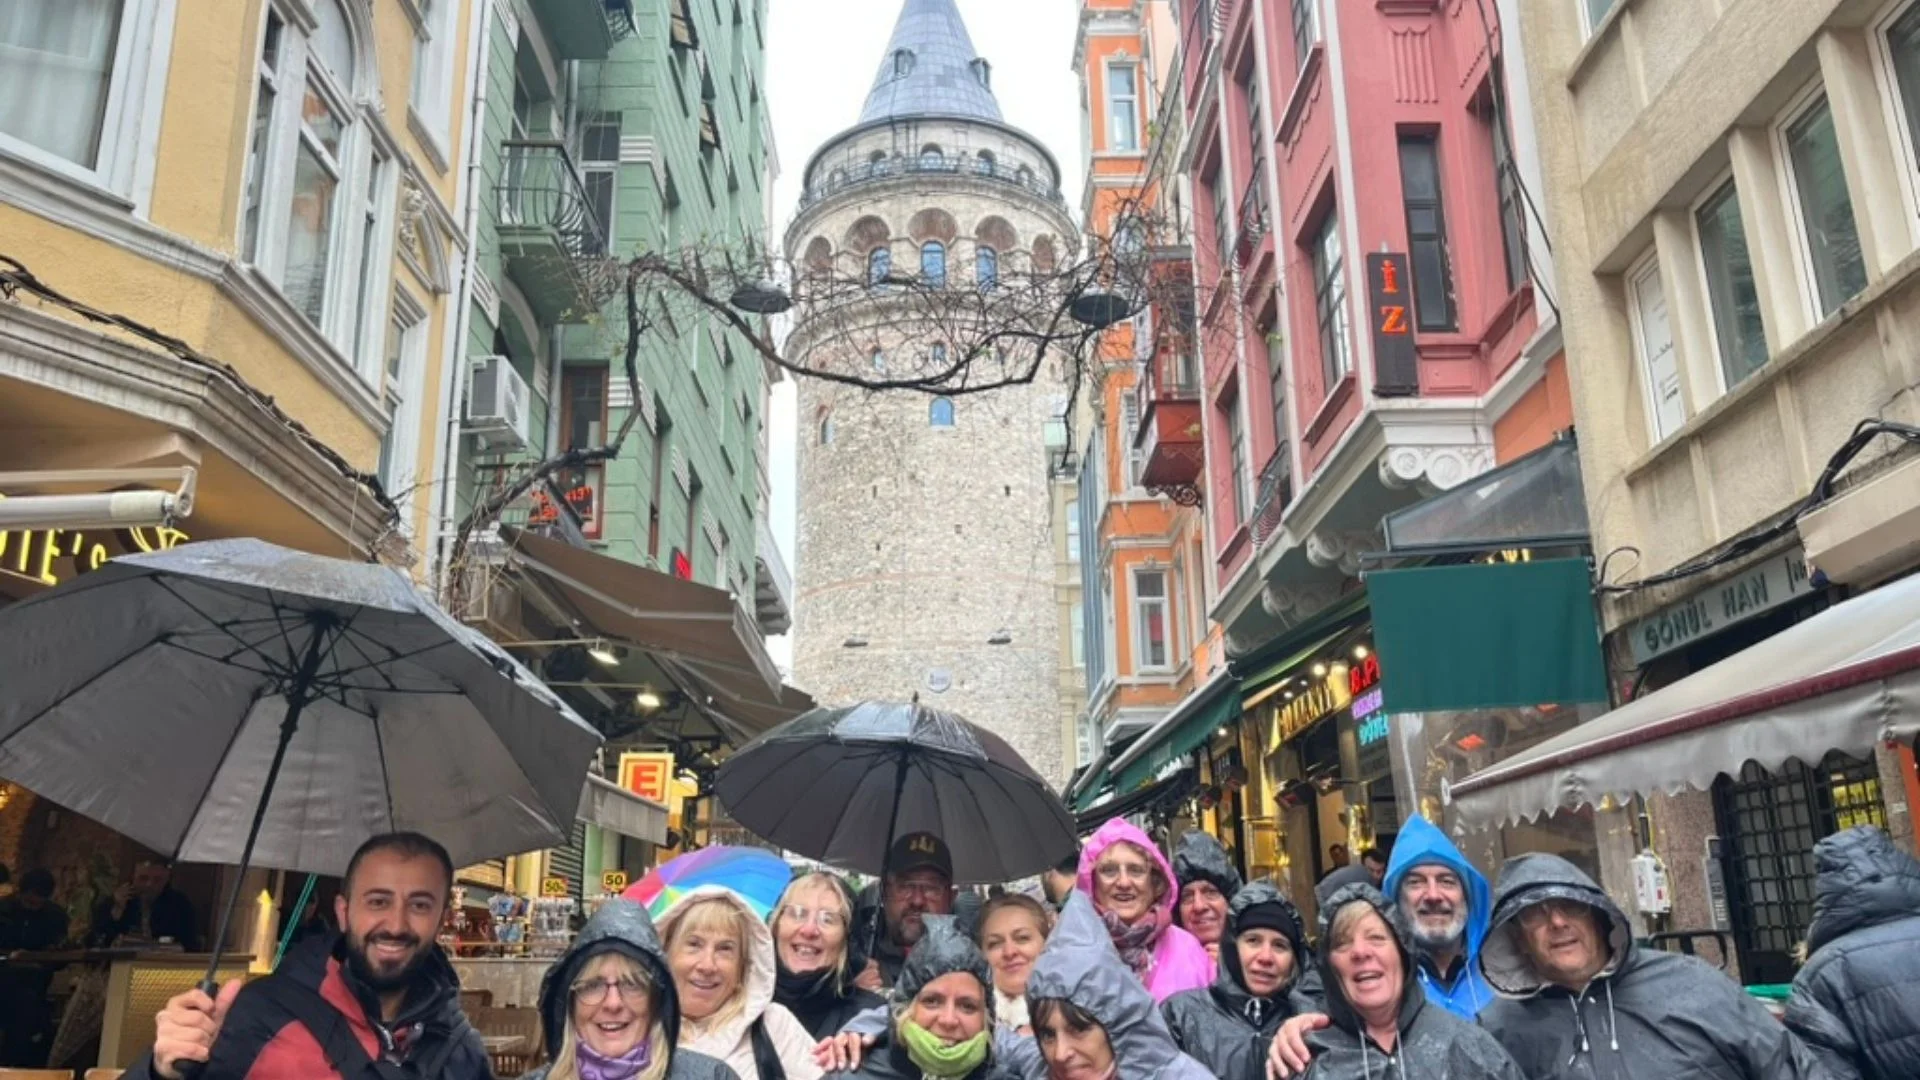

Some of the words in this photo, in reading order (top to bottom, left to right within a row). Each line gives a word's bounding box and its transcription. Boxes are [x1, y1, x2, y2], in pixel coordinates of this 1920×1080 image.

[1722, 572, 1769, 618] HAN
[632, 765, 658, 798] E
[605, 874, 623, 885] 50
